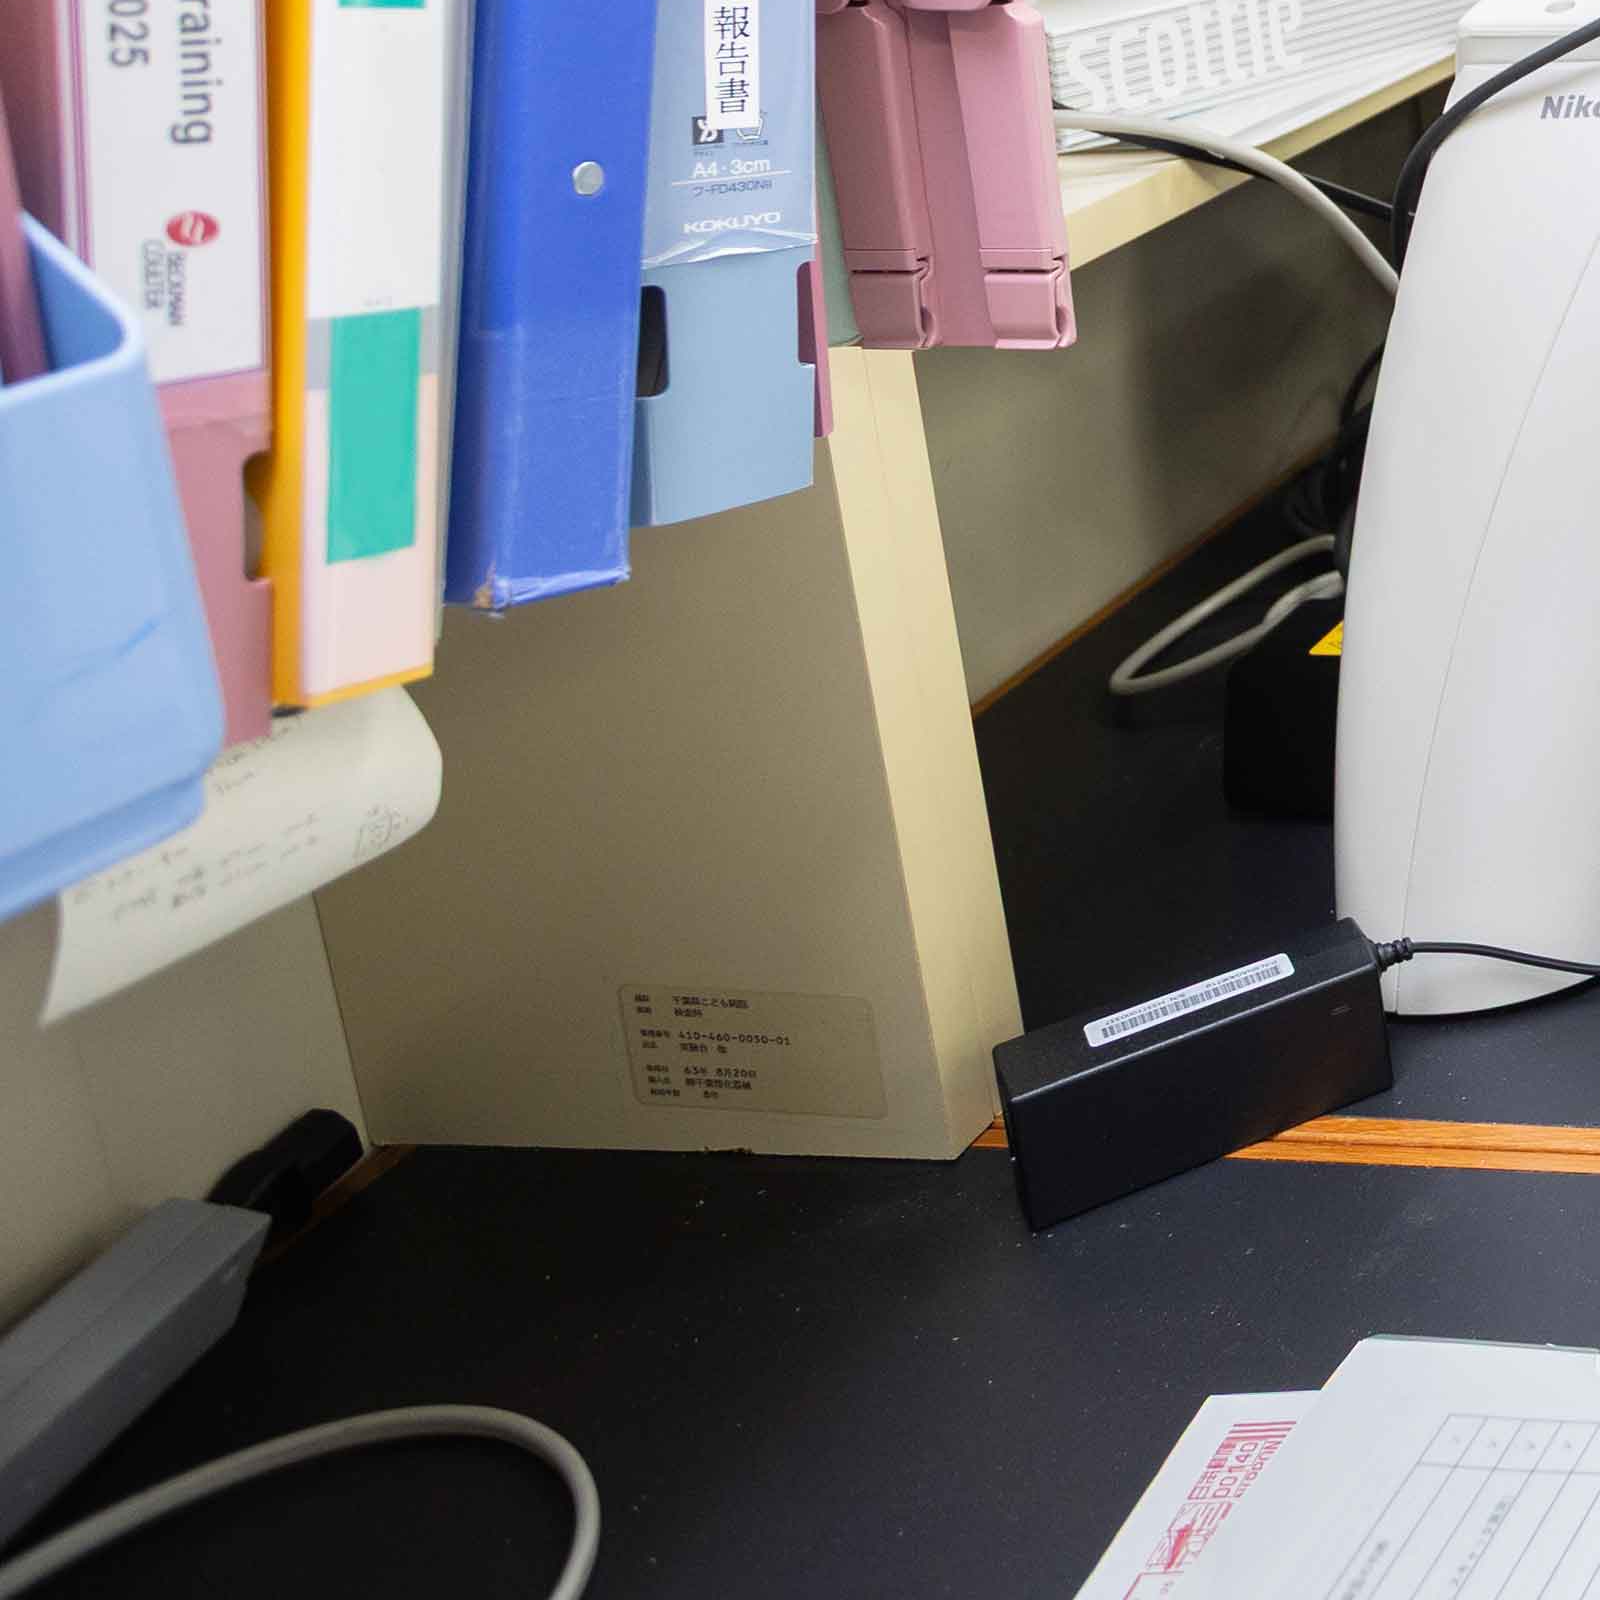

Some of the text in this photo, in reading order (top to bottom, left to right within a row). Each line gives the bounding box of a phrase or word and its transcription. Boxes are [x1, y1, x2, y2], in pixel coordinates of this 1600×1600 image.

[713, 5, 751, 114] 報告書
[682, 211, 782, 234] KOKUYO
